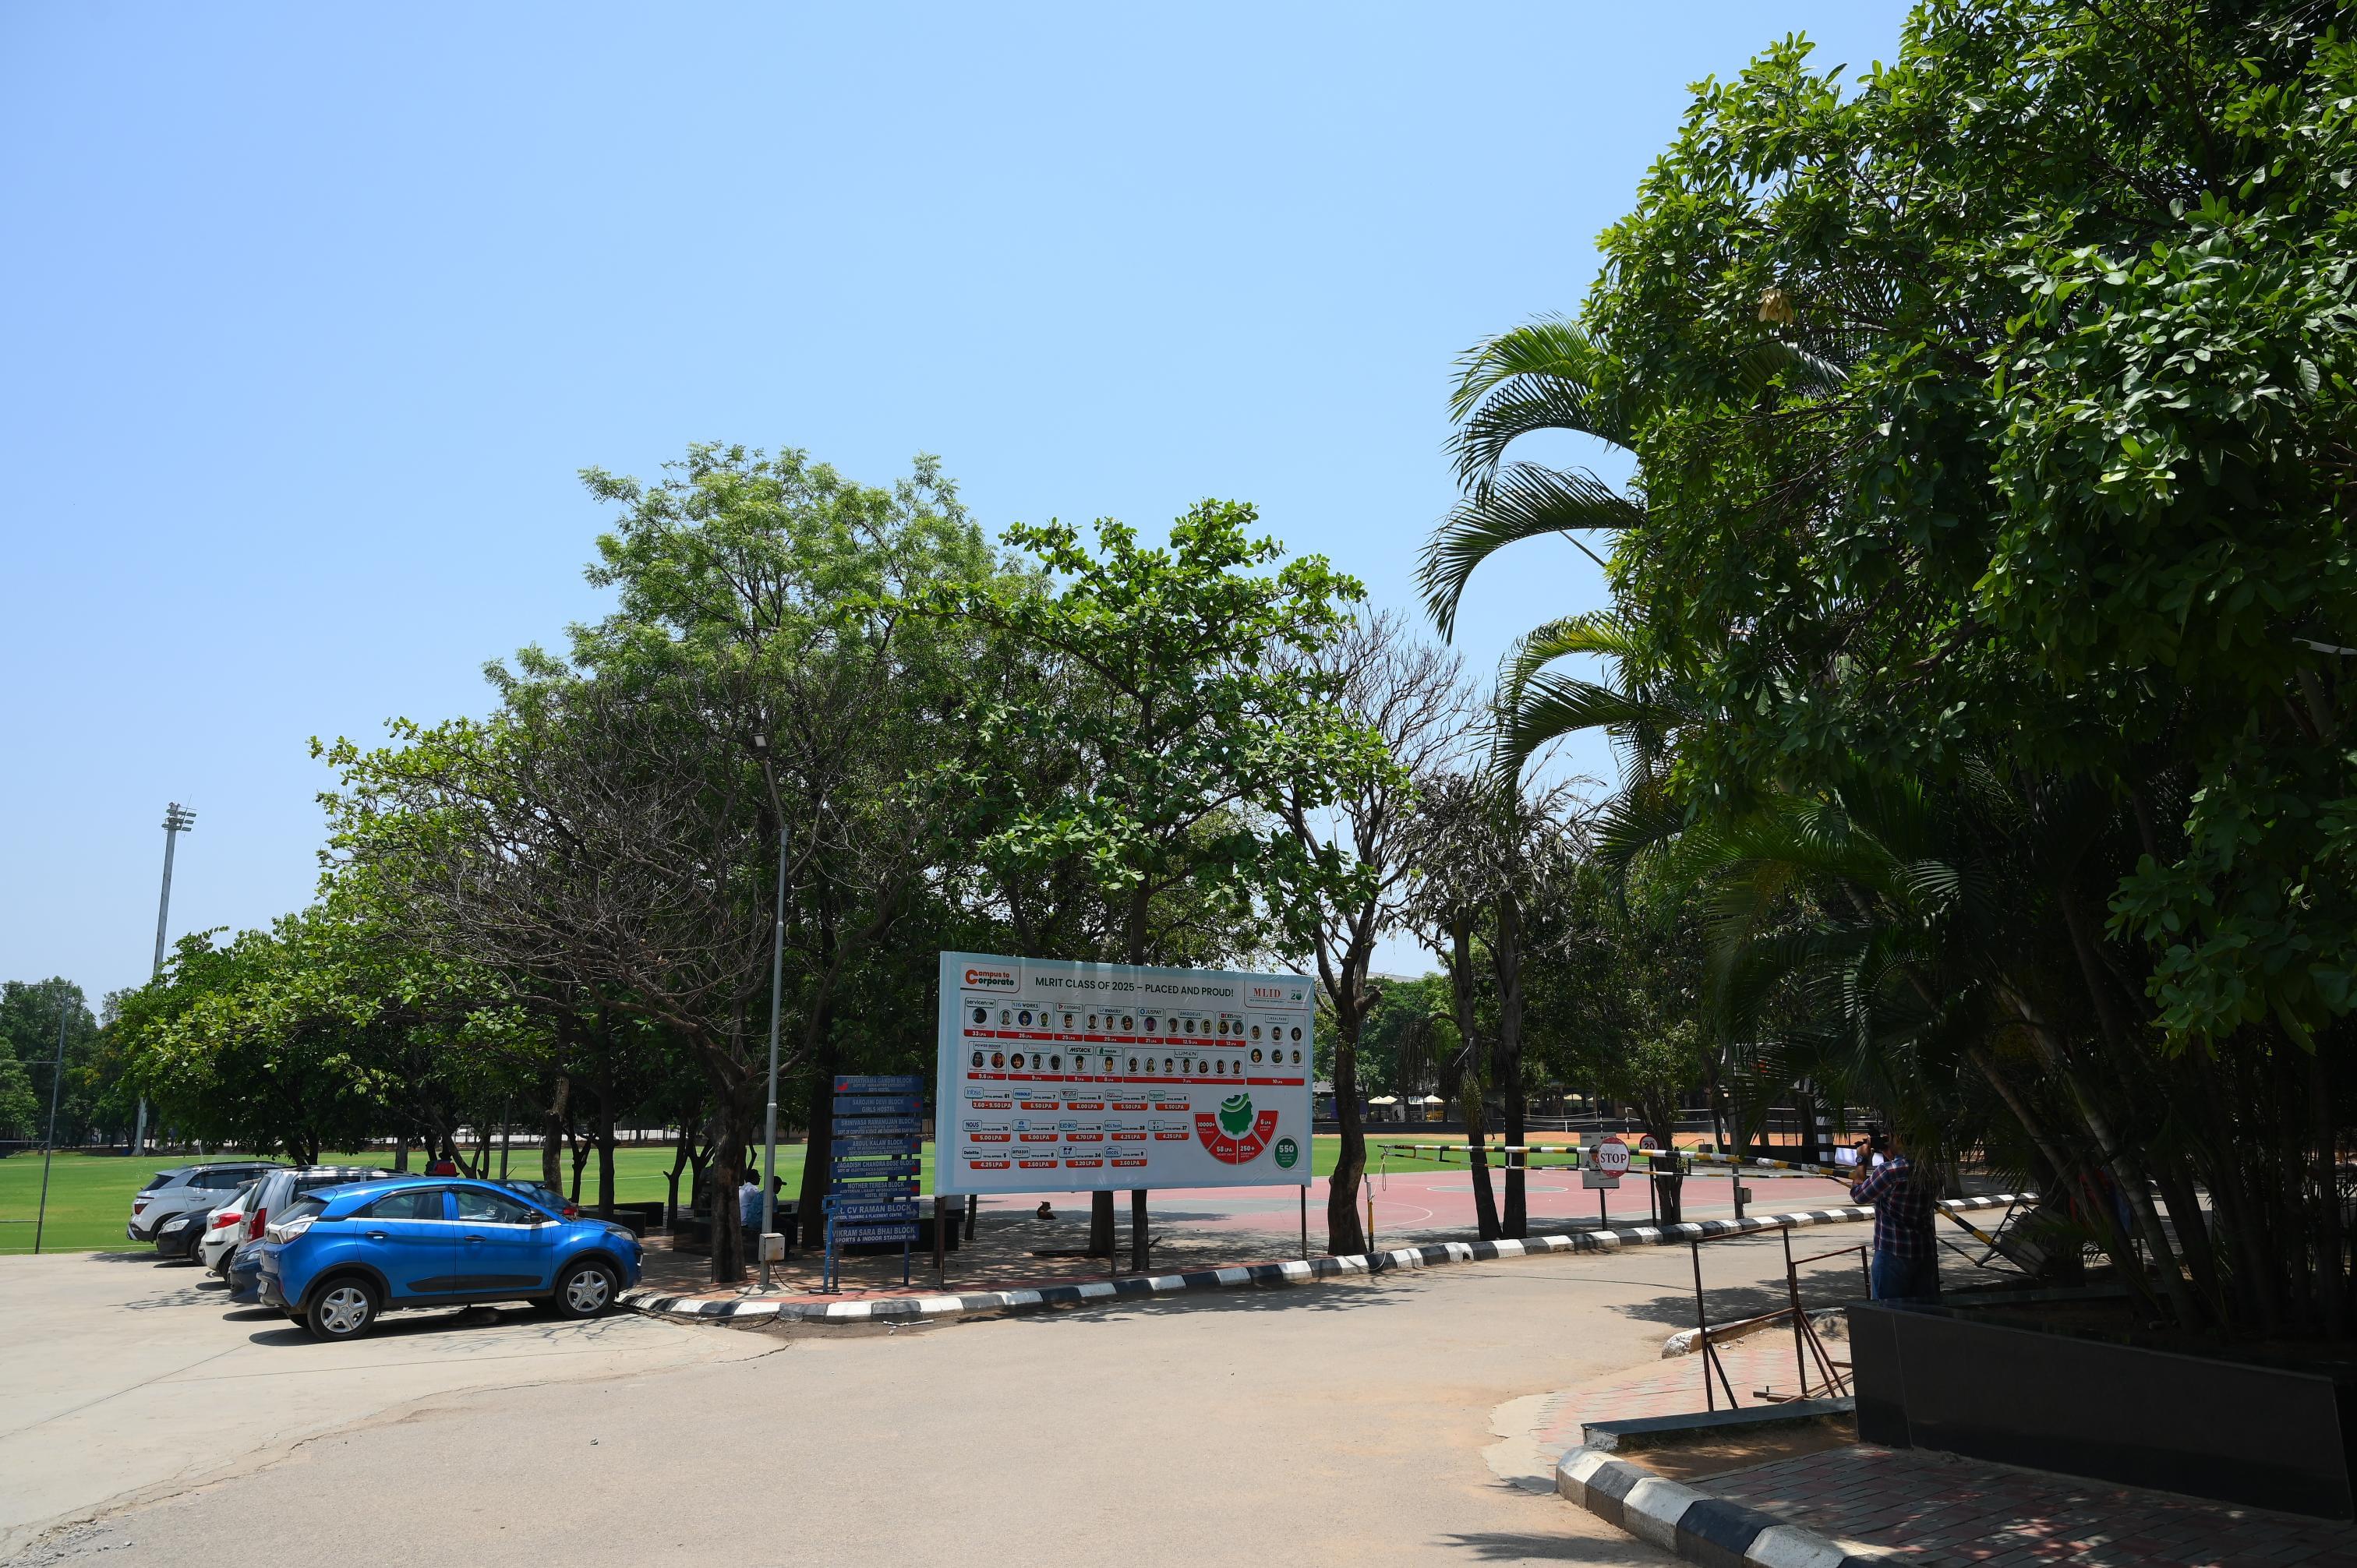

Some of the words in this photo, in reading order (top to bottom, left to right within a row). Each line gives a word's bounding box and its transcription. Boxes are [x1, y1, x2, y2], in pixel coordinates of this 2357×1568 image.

[1035, 977, 1063, 987] MLRIT
[1065, 980, 1095, 989] CLASS
[1098, 981, 1110, 990] OF
[1112, 982, 1134, 991] 2025
[1145, 984, 1178, 994] PLACED
[1202, 988, 1234, 997] PROUD!
[1279, 1145, 1295, 1153] 550
[1600, 1153, 1627, 1163] STOP
[832, 1229, 857, 1238] VIKRAM
